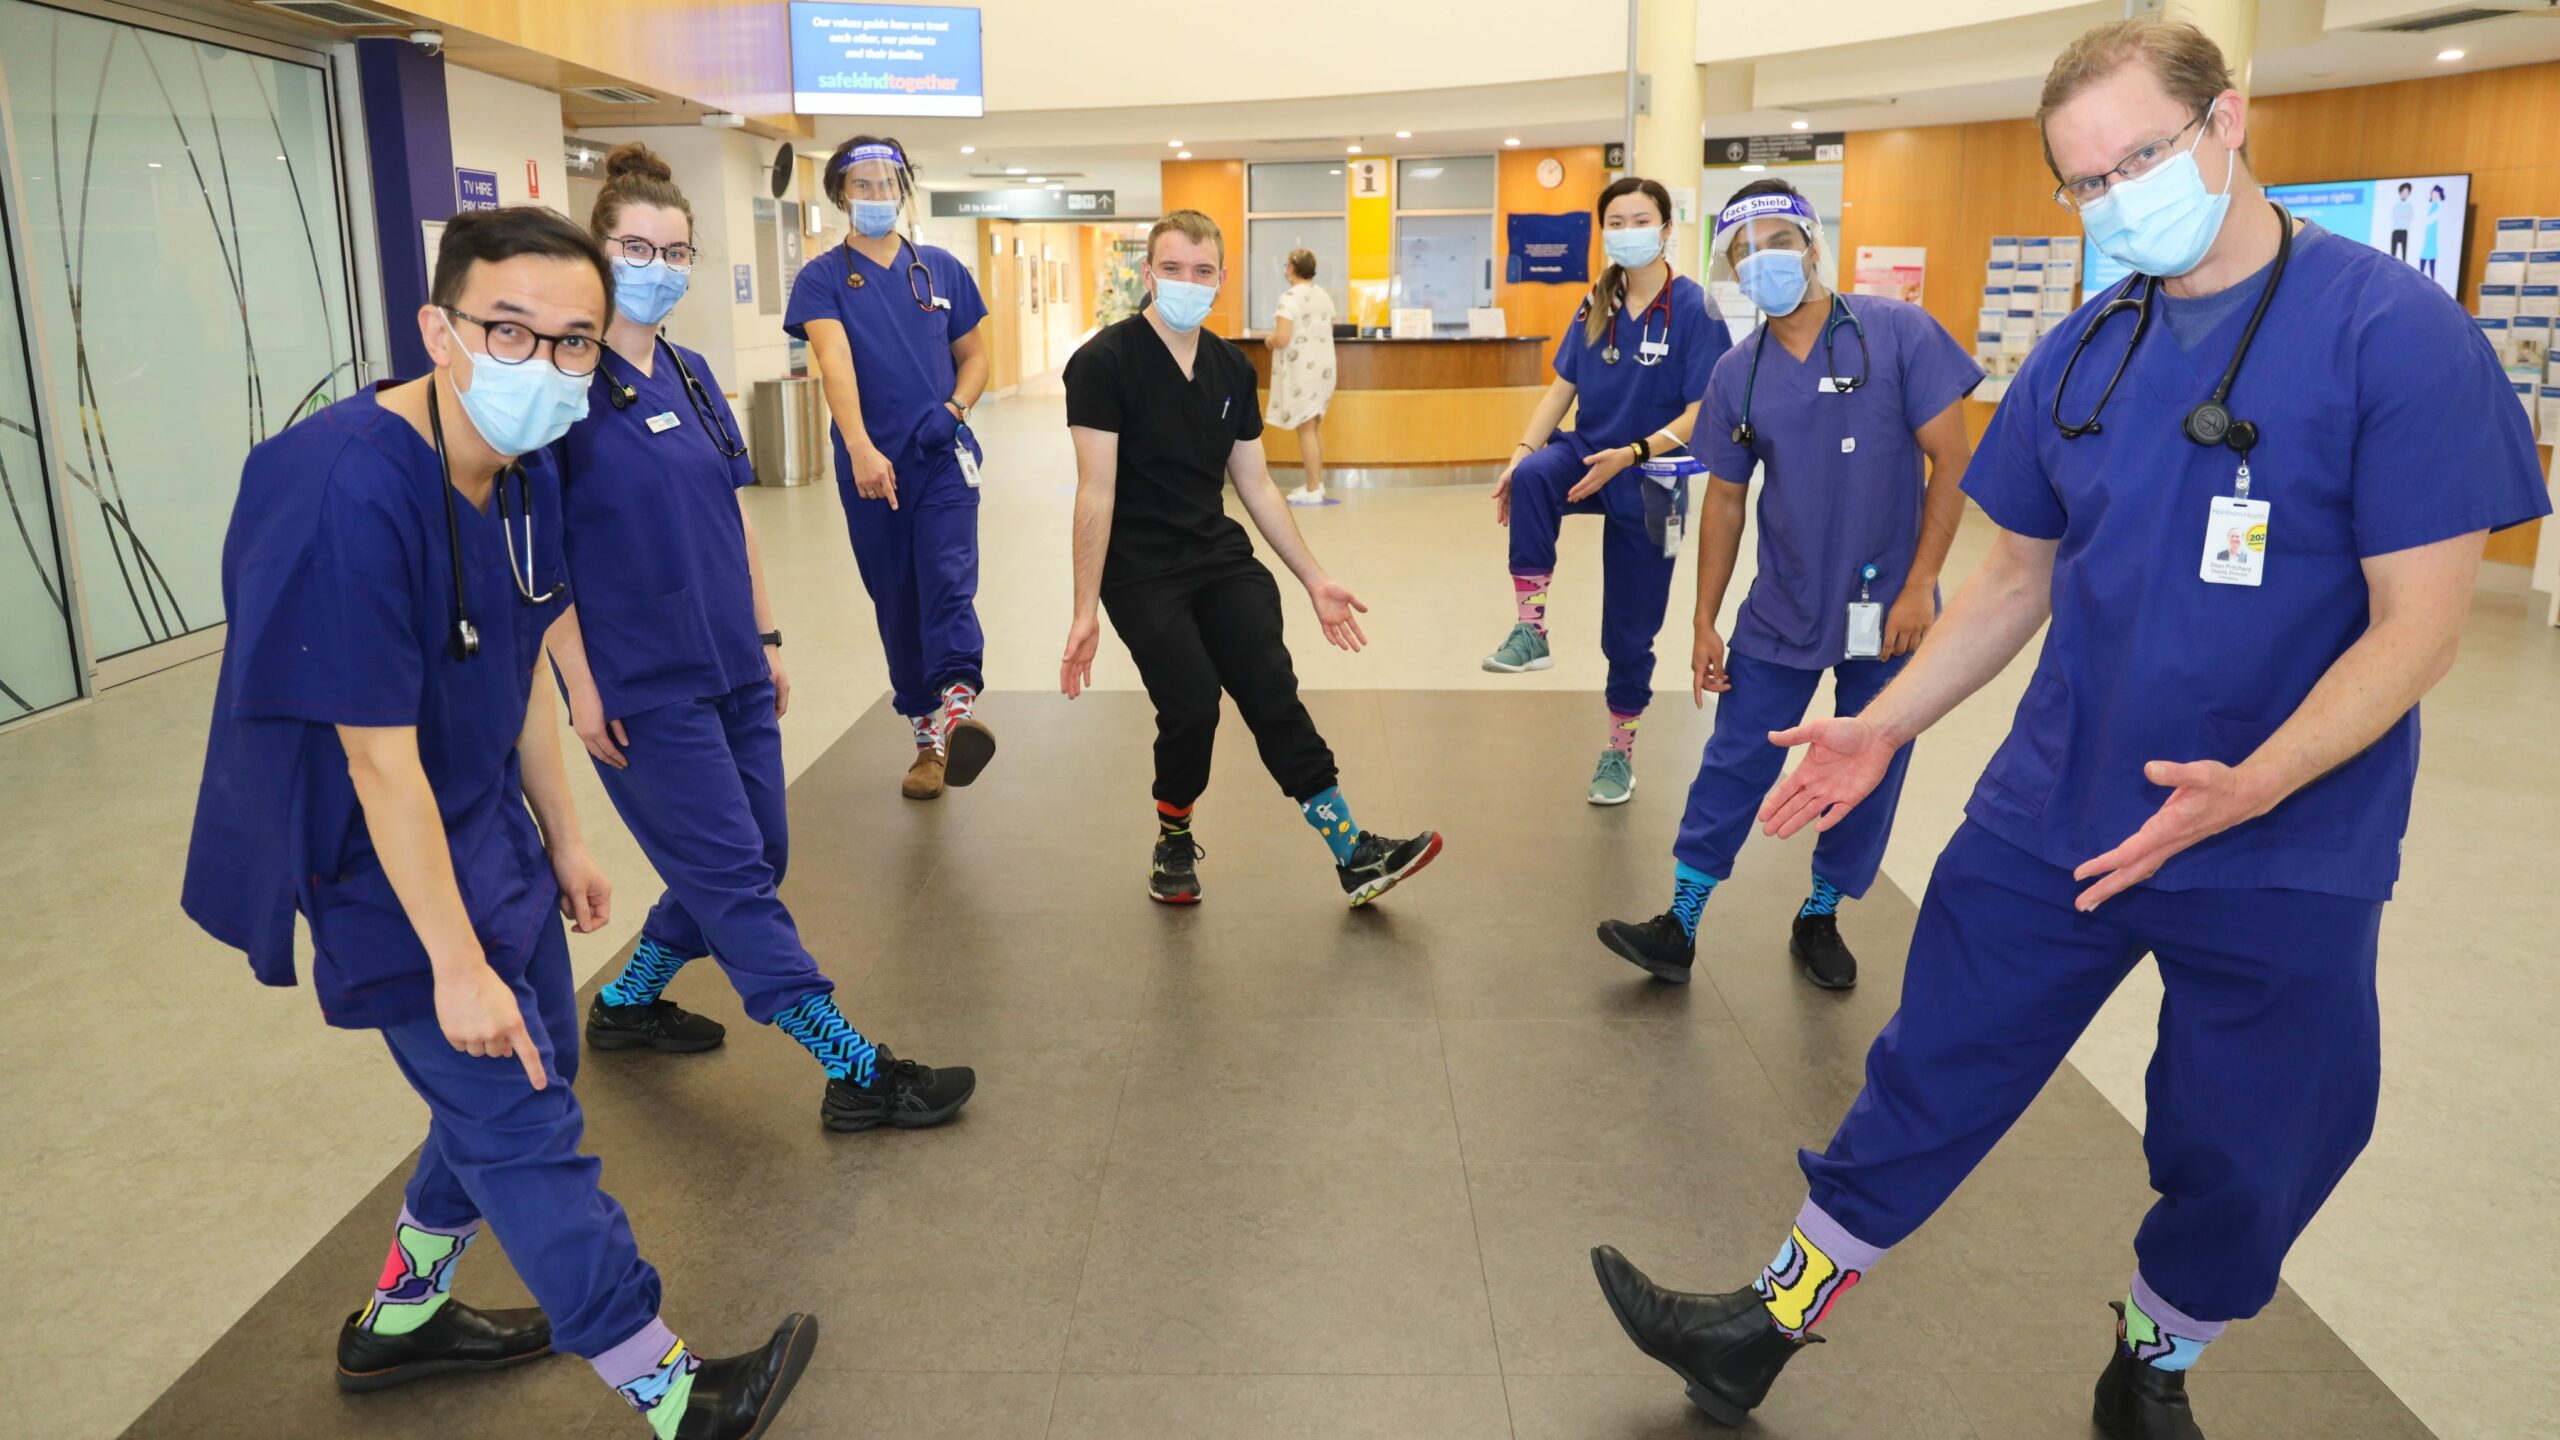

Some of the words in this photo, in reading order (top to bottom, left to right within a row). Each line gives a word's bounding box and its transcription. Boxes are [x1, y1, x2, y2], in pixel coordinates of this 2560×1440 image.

[812, 17, 830, 28] Our
[832, 18, 862, 29] values
[863, 18, 888, 31] guide
[890, 18, 910, 30] how
[911, 21, 925, 31] we
[926, 20, 949, 32] treat
[829, 33, 851, 43] each
[881, 35, 897, 44] our
[898, 35, 936, 46] patients
[845, 48, 864, 59] and
[865, 48, 887, 59] their
[888, 49, 924, 61] families
[818, 71, 959, 93] safekindtogether
[463, 180, 474, 194] TV
[475, 181, 494, 197] HIRE
[2283, 193, 2309, 205] health
[2310, 195, 2328, 204] care
[2329, 192, 2355, 205] rights
[462, 199, 477, 212] PAY
[959, 203, 971, 212] Lift
[972, 203, 980, 212] to
[1725, 203, 1748, 219] Face
[1750, 197, 1787, 209] Shield
